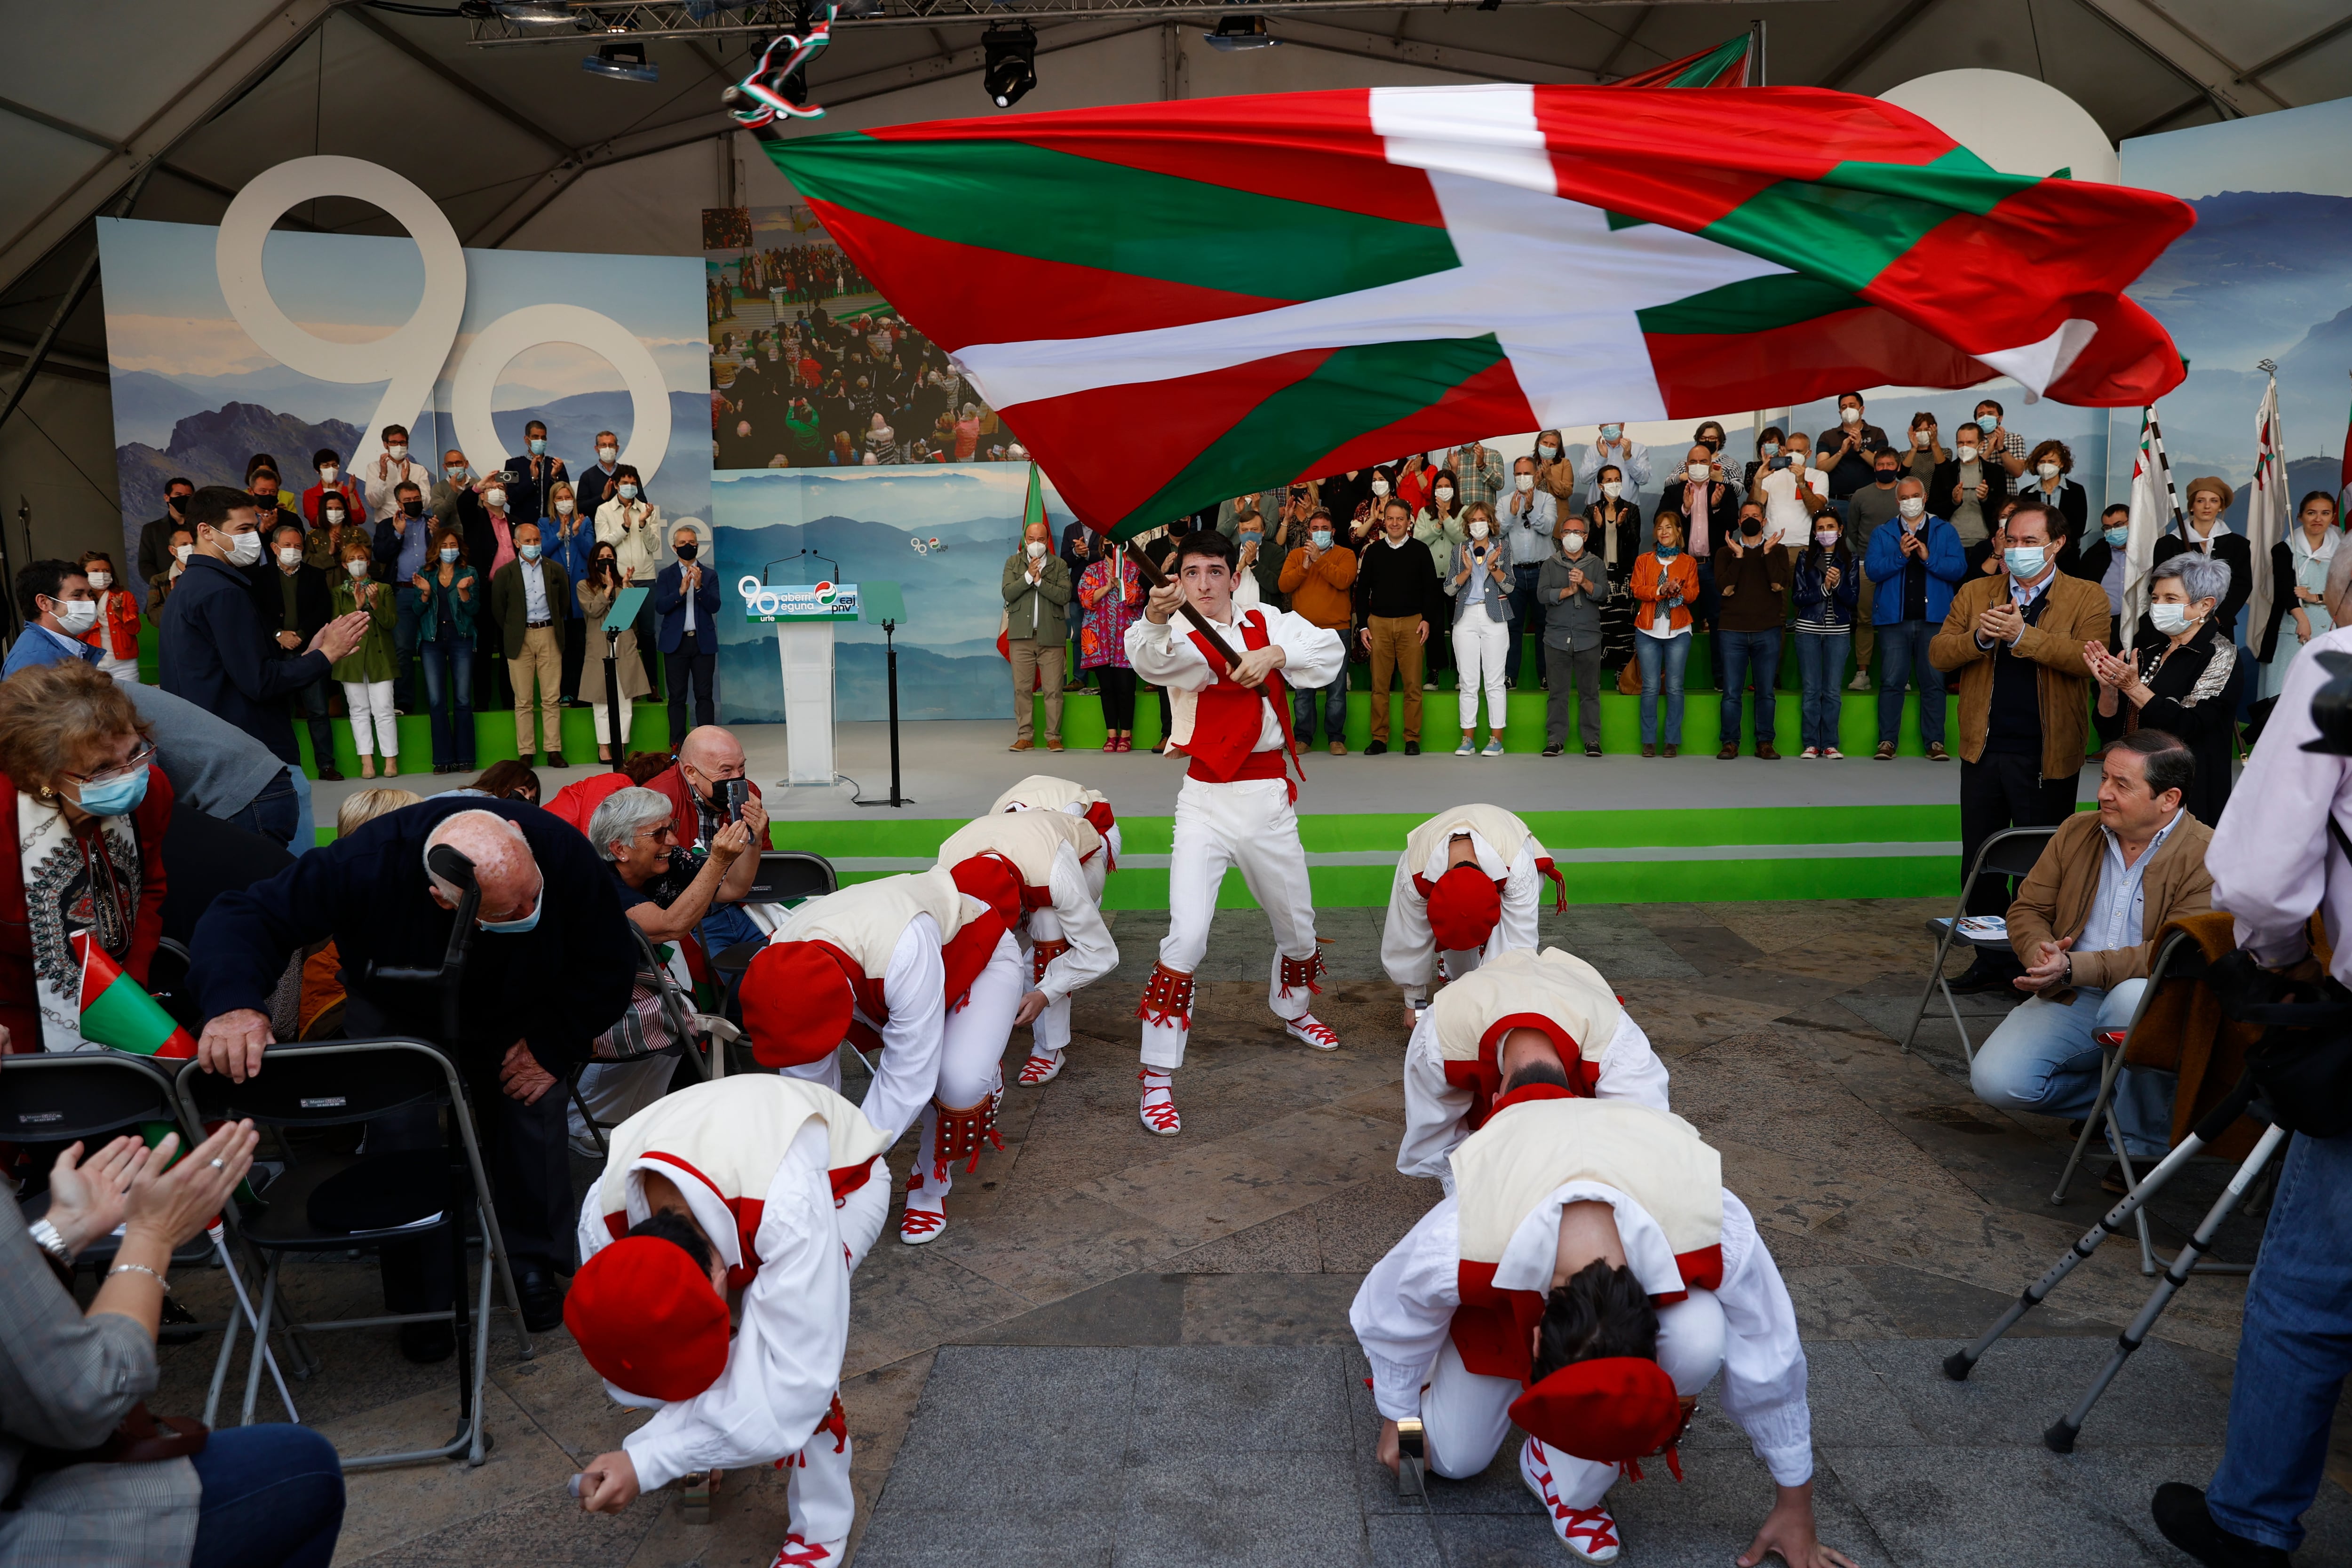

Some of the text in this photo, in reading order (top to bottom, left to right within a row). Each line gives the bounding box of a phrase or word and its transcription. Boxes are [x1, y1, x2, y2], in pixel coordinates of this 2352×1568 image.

[216, 155, 671, 492] 90
[911, 537, 927, 554] 90
[738, 575, 779, 615] 90
[781, 593, 810, 602] aberri
[840, 595, 855, 606] eaj
[781, 603, 814, 613] eguna
[832, 605, 851, 614] pnv
